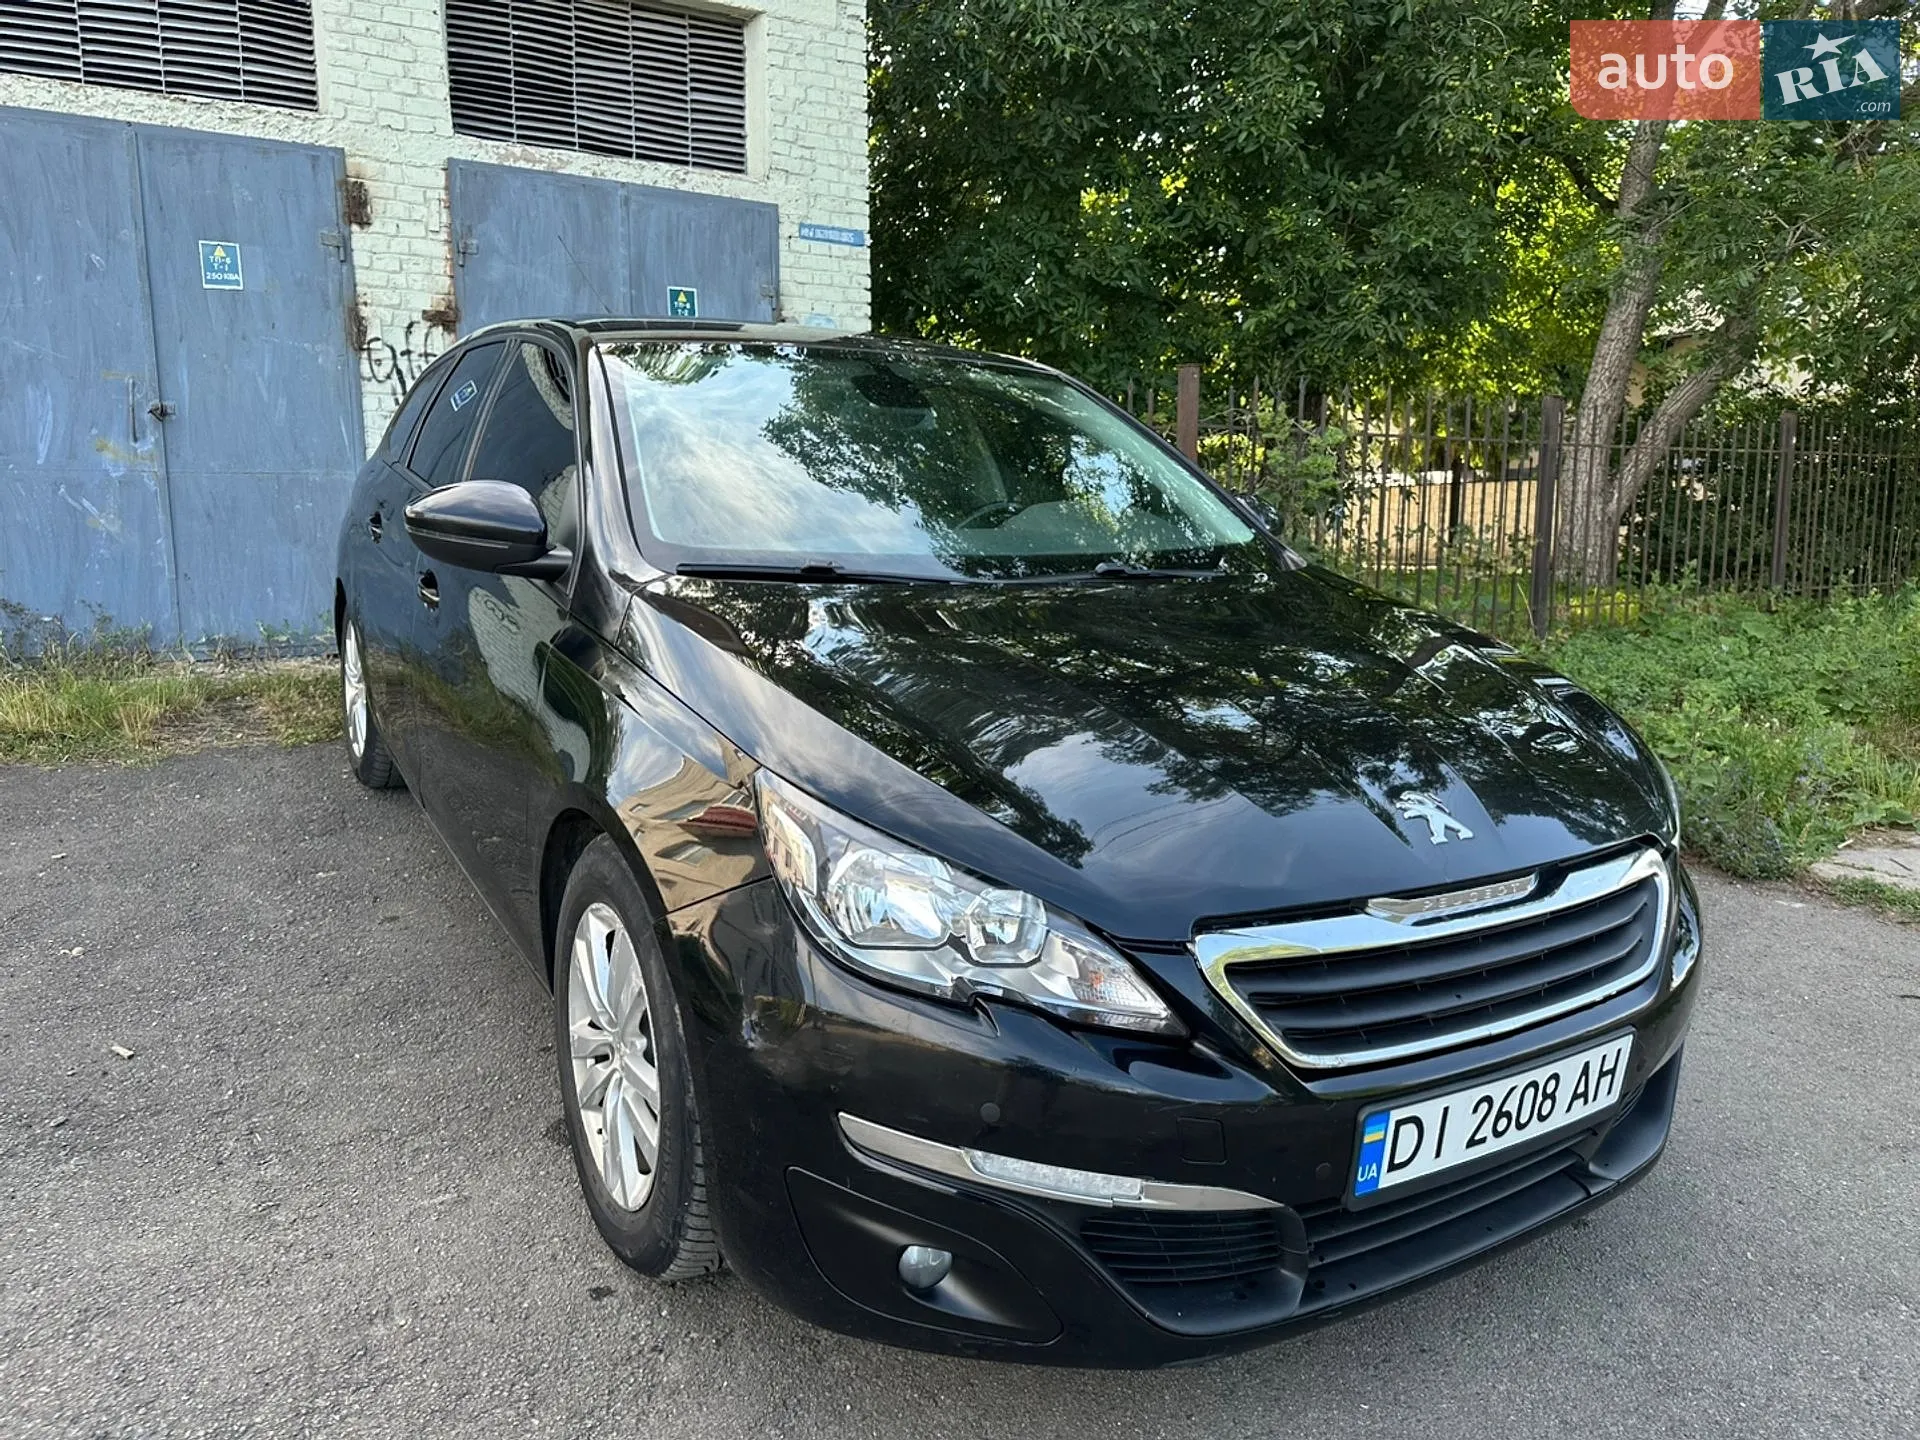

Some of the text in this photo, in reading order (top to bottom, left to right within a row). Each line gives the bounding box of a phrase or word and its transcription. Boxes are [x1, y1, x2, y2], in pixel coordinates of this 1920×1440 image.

[206, 271, 223, 280] 250
[1422, 882, 1521, 912] PEUGEOT
[1386, 1048, 1622, 1173] DI 2608 AH
[1357, 1162, 1378, 1182] UA
